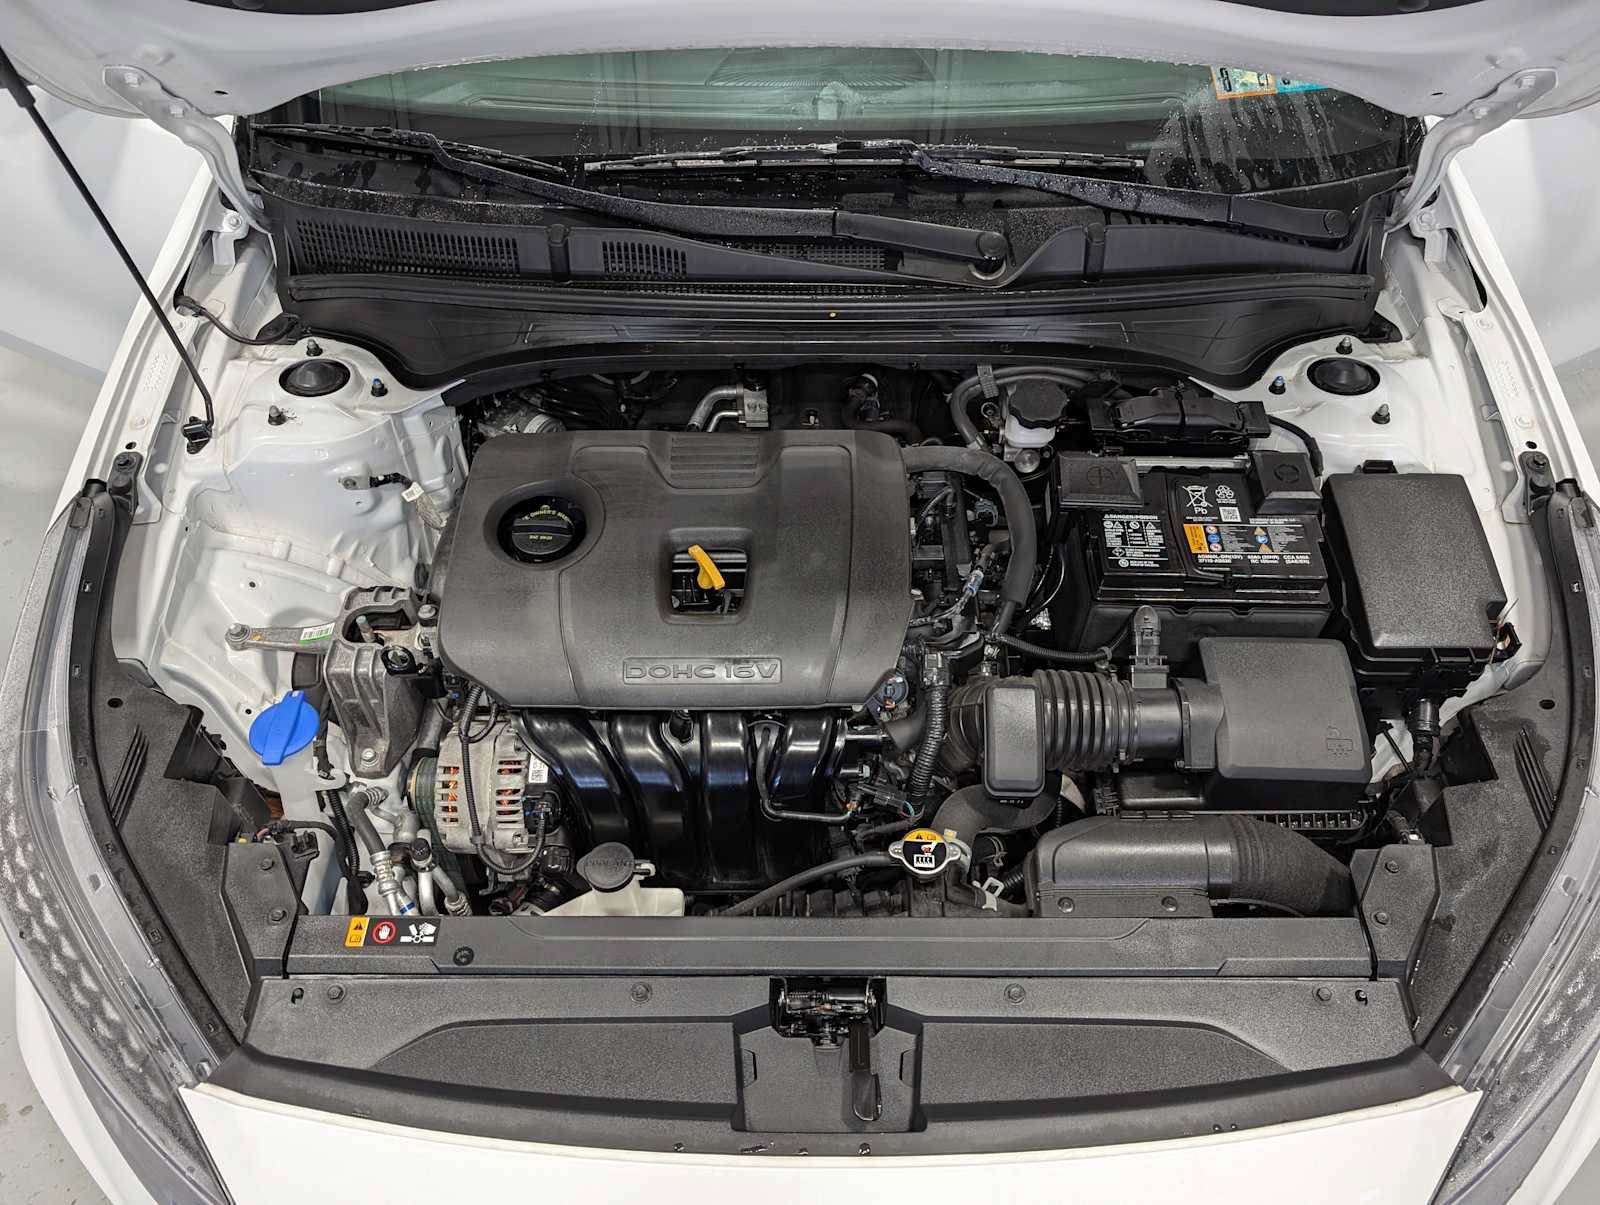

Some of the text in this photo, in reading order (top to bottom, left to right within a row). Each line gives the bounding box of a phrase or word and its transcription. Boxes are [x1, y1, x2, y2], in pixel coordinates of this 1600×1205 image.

[1194, 507, 1208, 515] Pb
[625, 663, 778, 679] DOHC 16V
